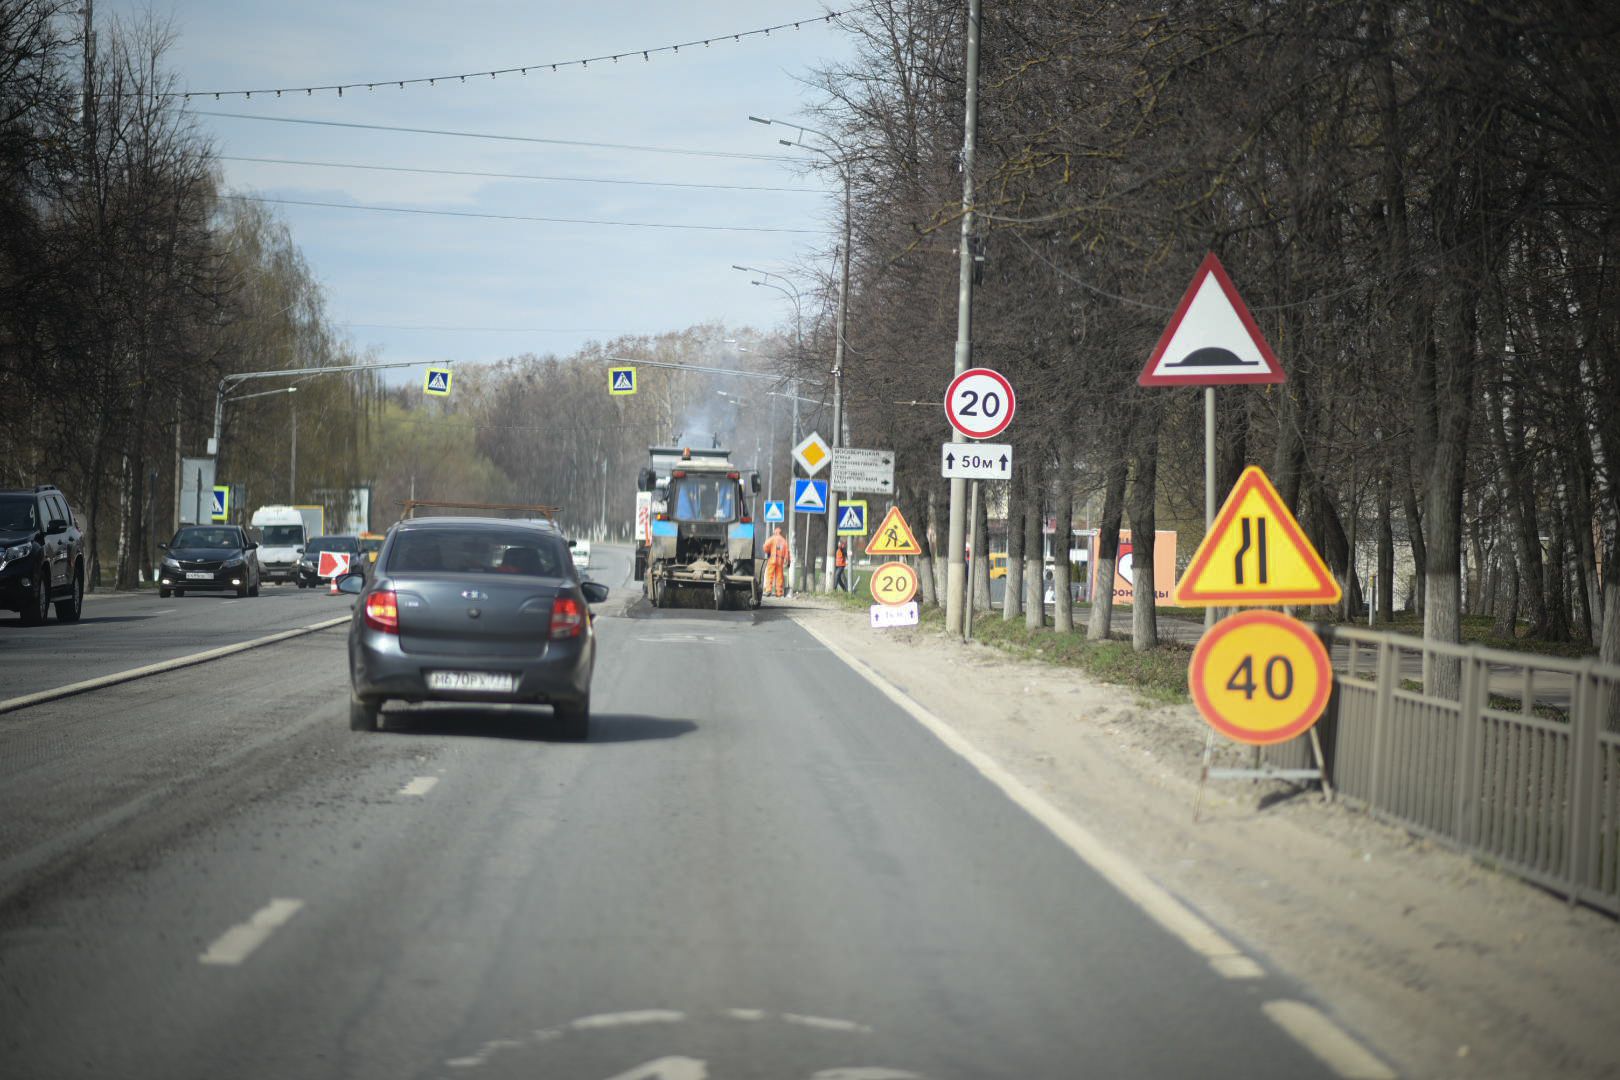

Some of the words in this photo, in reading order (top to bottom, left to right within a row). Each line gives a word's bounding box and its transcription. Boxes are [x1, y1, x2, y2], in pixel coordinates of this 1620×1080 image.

[959, 390, 1000, 418] 20
[962, 455, 992, 468] 50м
[881, 576, 907, 592] 20
[1226, 654, 1294, 701] 40
